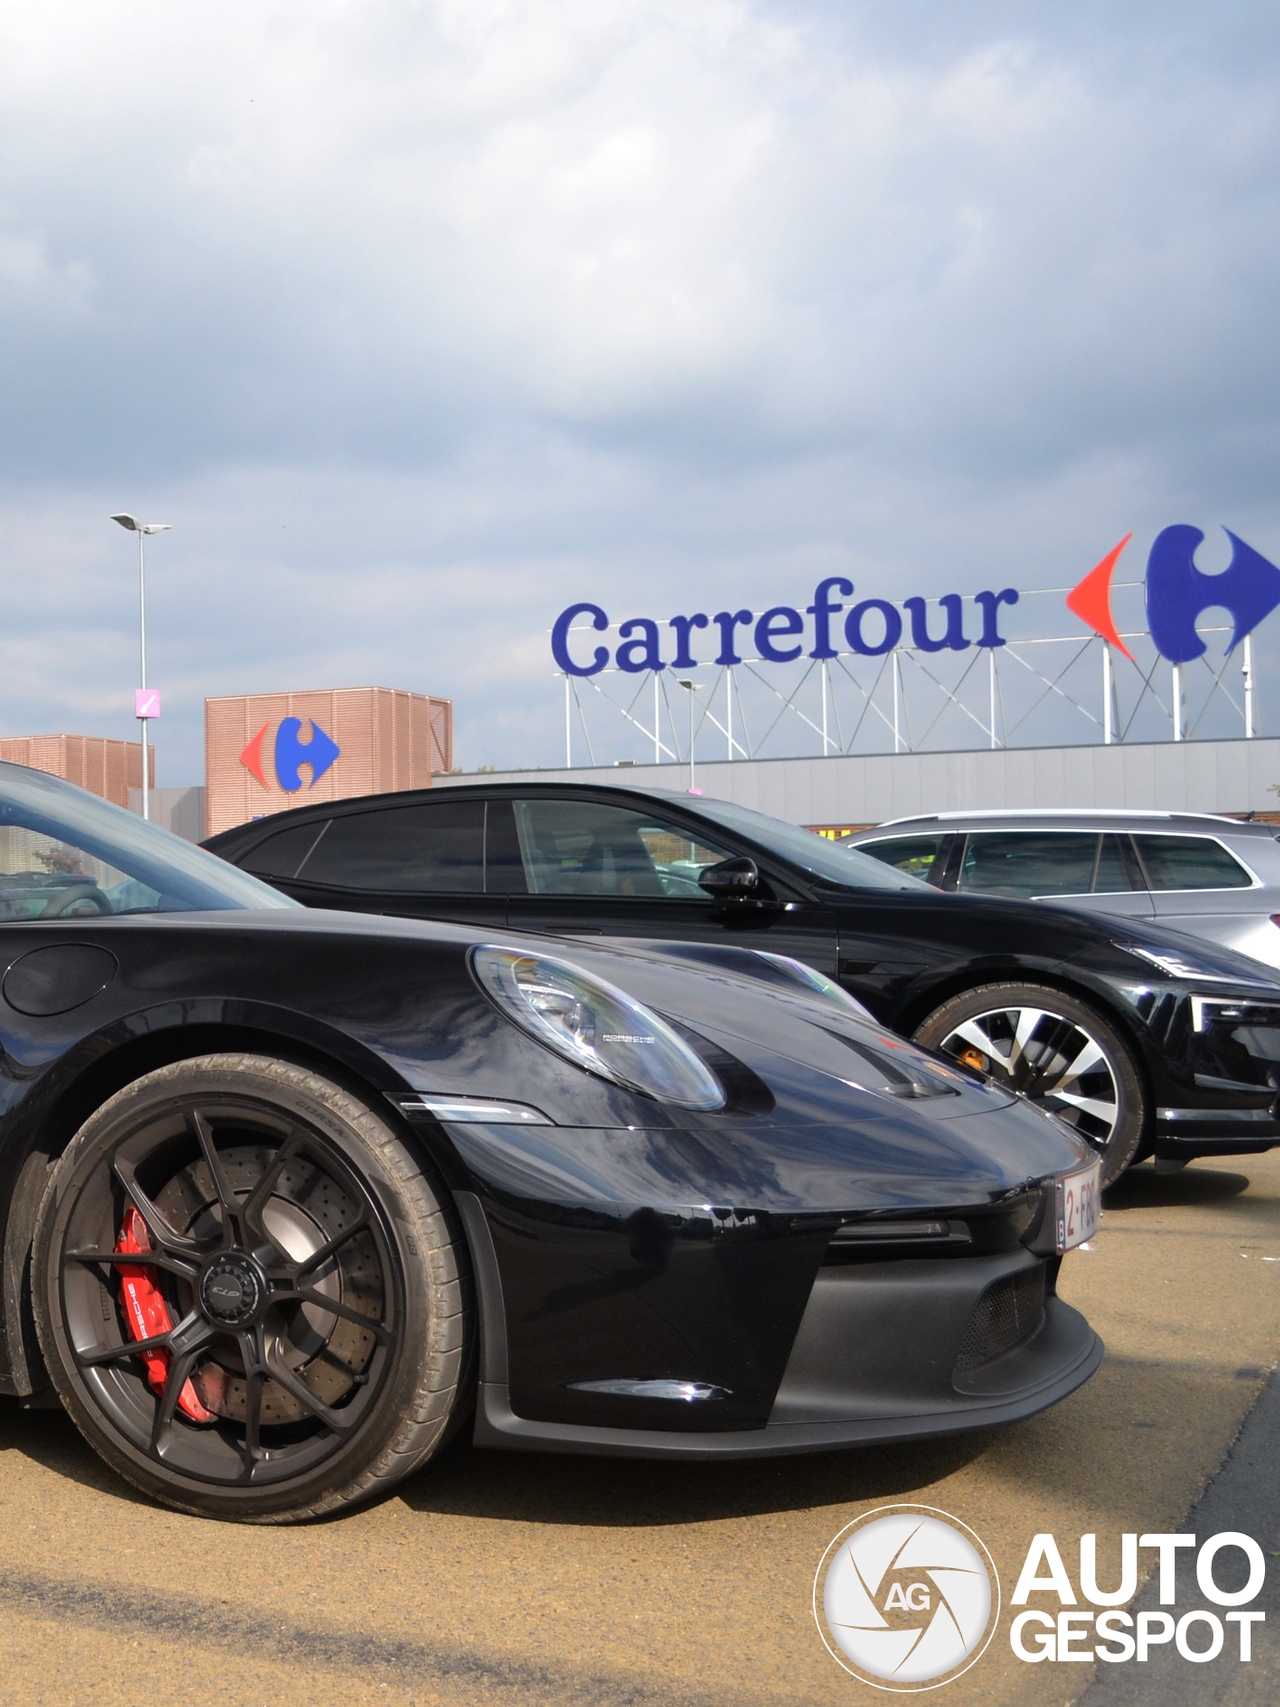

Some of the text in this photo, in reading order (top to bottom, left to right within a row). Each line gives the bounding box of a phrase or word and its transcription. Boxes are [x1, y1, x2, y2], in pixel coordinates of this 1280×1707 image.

[551, 577, 1019, 677] Carrefour
[294, 1099, 346, 1139] CORSA
[127, 1283, 154, 1357] PRSCHE
[211, 1286, 240, 1297] GT3
